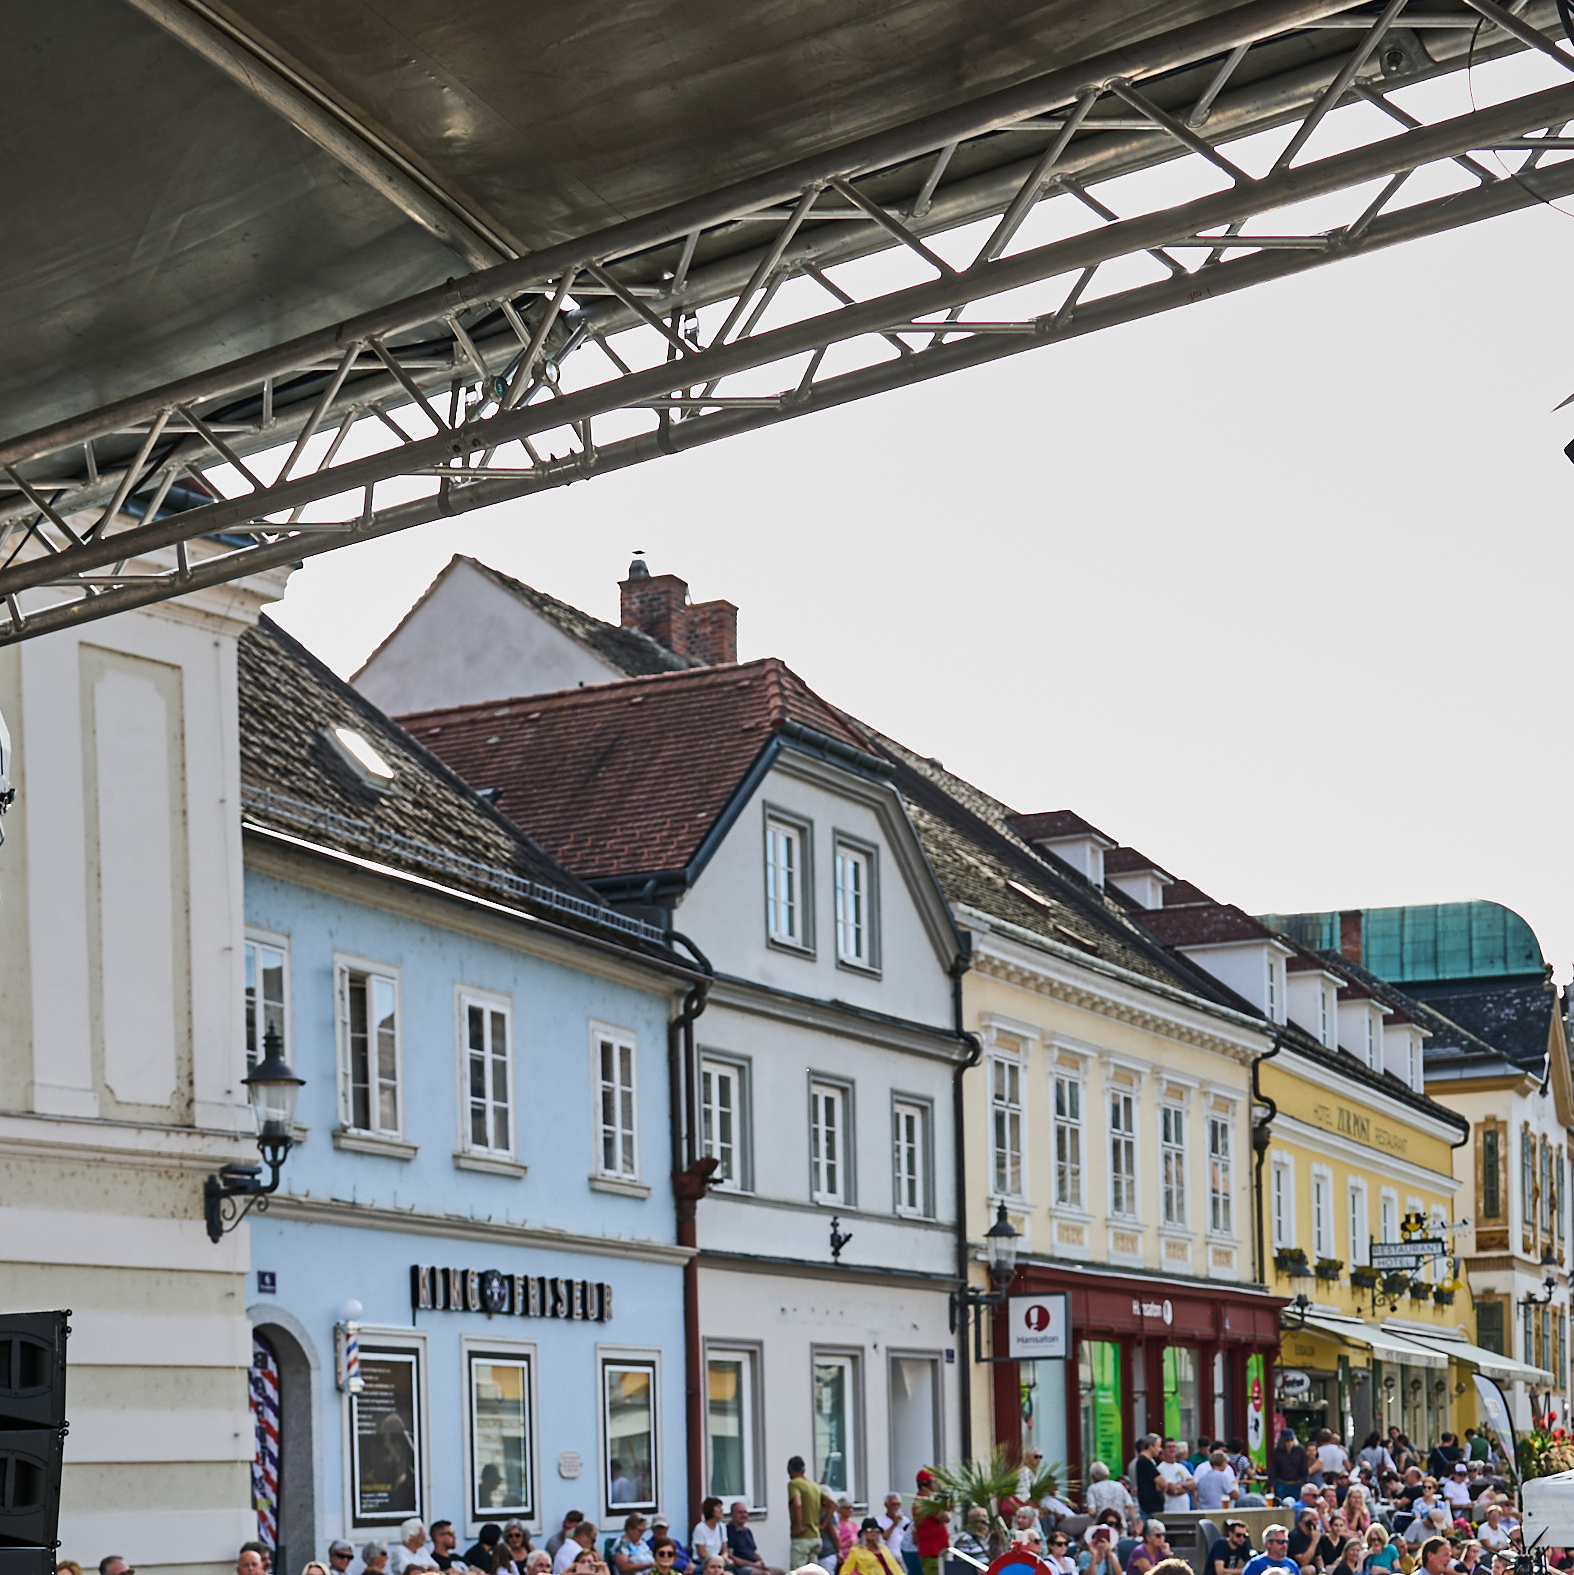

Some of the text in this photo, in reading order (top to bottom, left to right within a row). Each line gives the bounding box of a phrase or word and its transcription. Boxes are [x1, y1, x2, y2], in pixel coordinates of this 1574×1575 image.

[1373, 1243, 1441, 1254] RESTAURANT
[1377, 1257, 1411, 1267] HOTEL
[418, 1264, 614, 1321] KING FRISEUR
[1016, 1334, 1059, 1345] Hansaton
